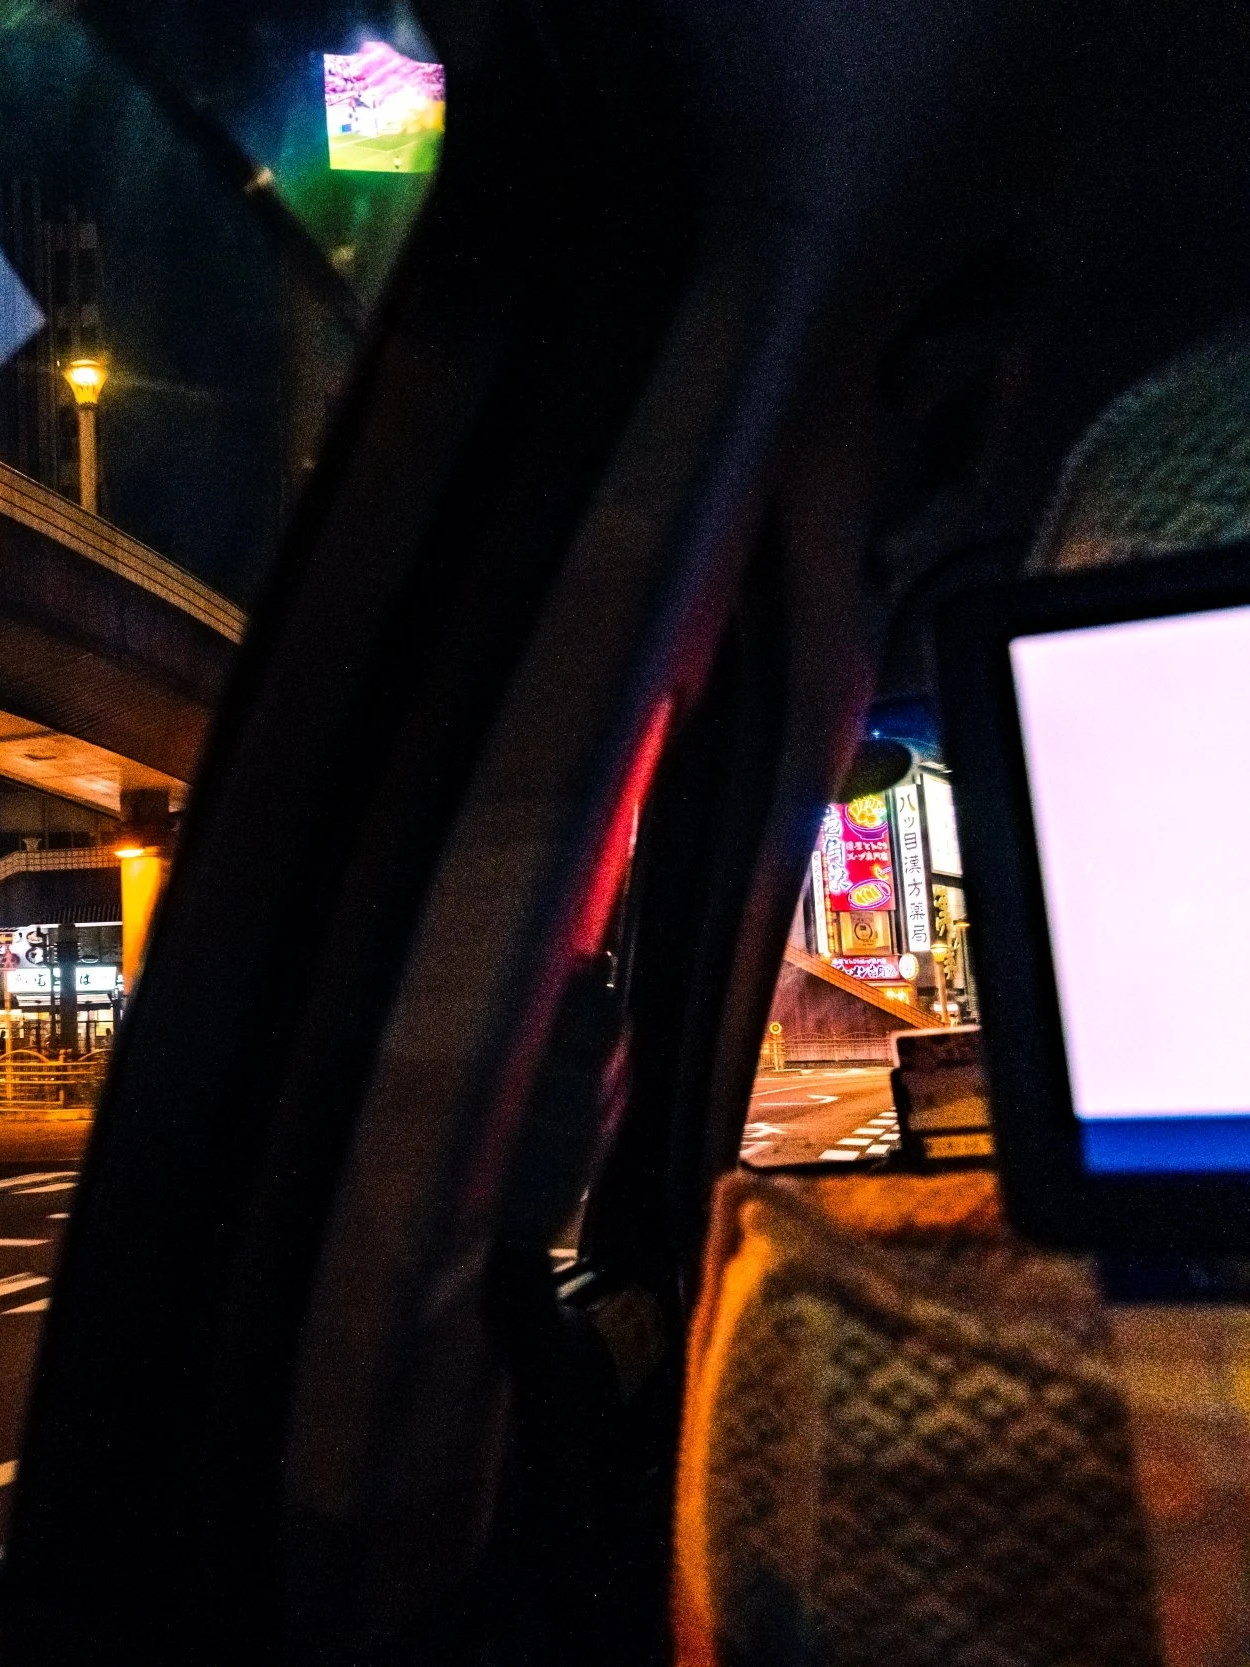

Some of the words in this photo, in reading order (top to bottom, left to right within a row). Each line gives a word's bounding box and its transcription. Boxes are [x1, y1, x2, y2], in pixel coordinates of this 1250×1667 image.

[899, 793, 928, 944] 八ツ目漢方薬局
